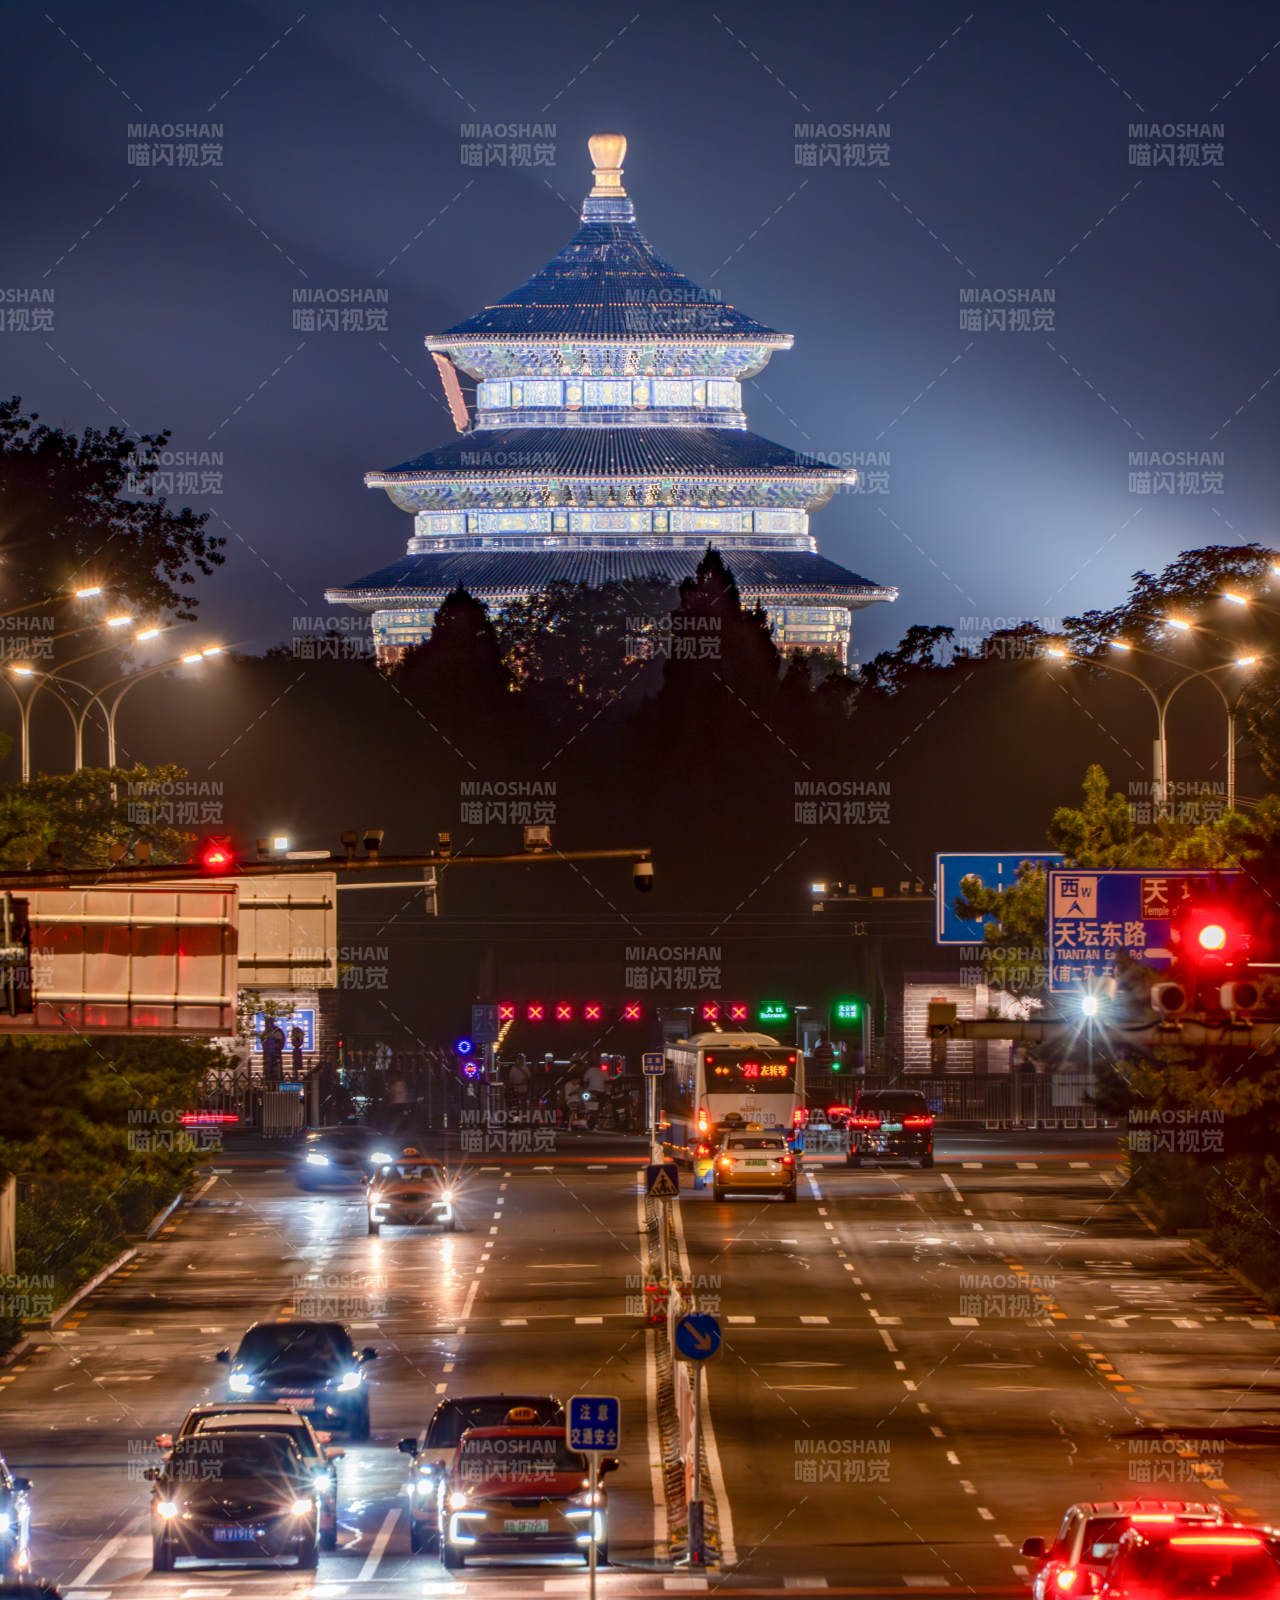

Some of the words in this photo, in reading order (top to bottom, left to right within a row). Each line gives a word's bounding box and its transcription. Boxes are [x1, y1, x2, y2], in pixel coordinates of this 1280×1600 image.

[1060, 878, 1080, 898] 西
[1081, 887, 1092, 897] W
[1144, 905, 1170, 916] Temple
[1054, 921, 1147, 947] 天坛东路
[1056, 949, 1100, 960] TIANTAN
[580, 1404, 609, 1421] 注意
[571, 1428, 617, 1446] 交通安全
